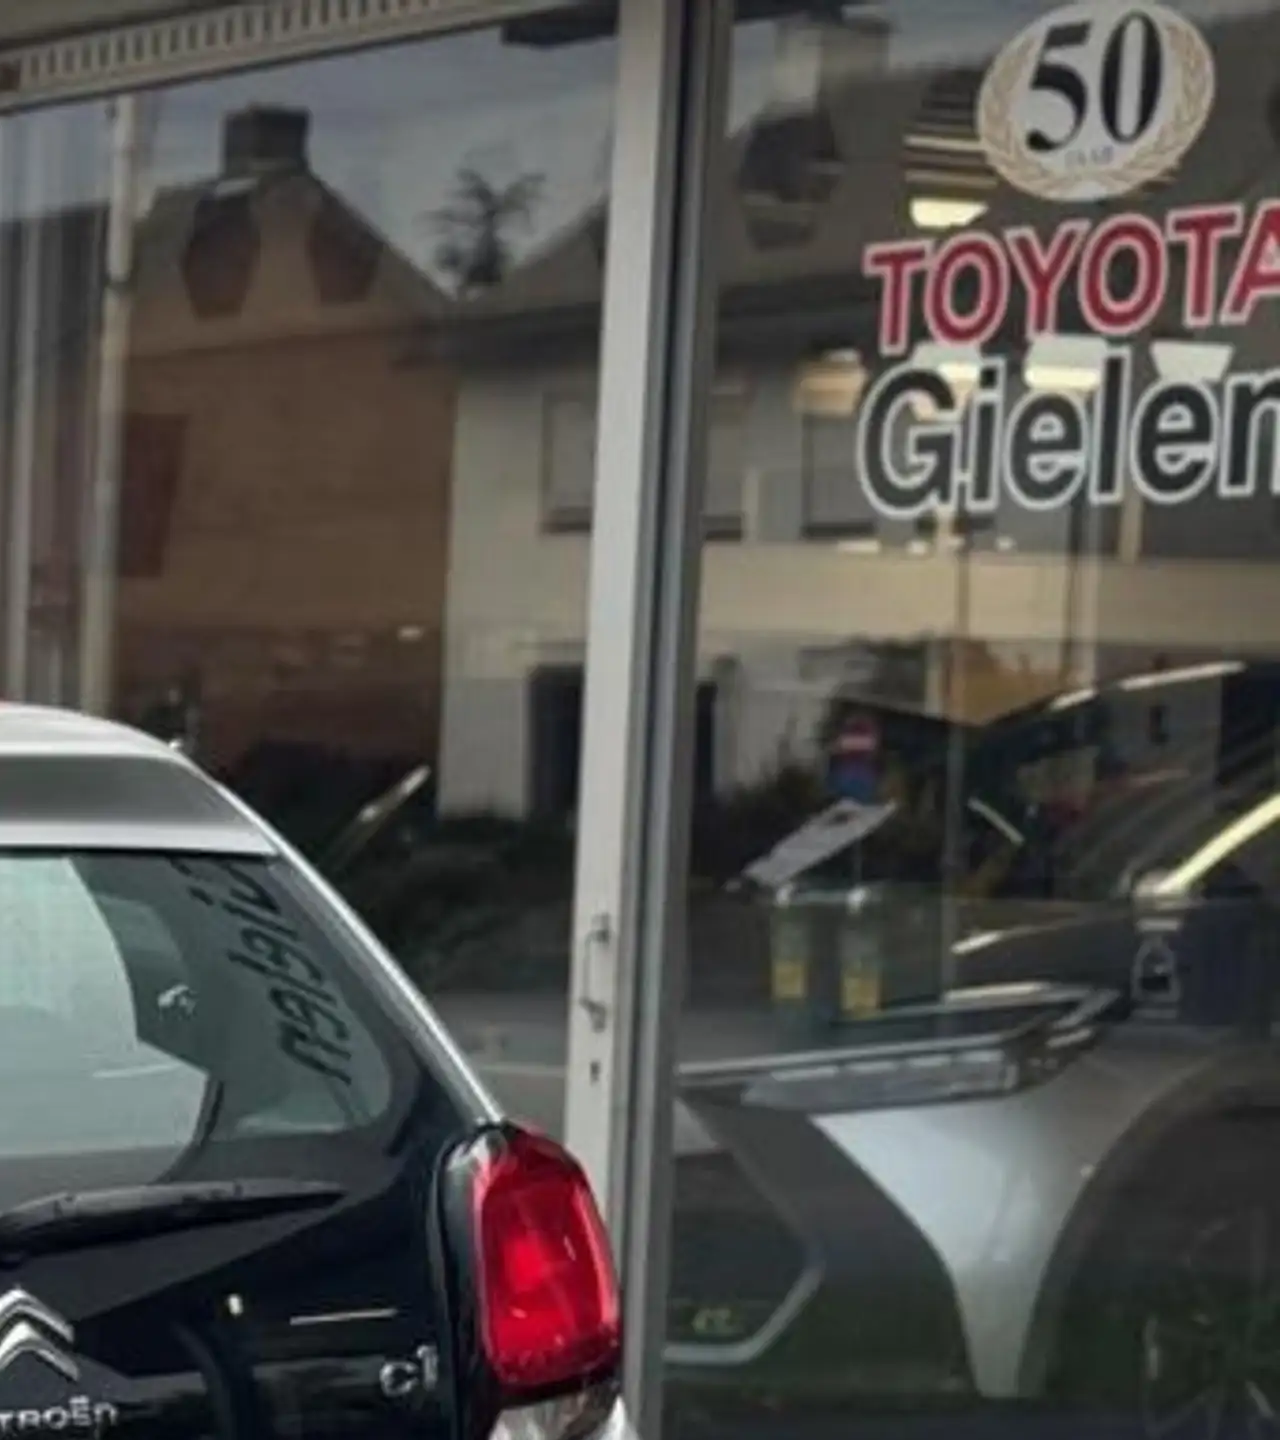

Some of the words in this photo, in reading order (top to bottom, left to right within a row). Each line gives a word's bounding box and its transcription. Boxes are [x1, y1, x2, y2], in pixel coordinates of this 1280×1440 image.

[1025, 10, 1163, 153] 50
[862, 199, 1280, 355] TOYOTA
[856, 346, 1280, 519] Gielen
[379, 1344, 438, 1397] C1
